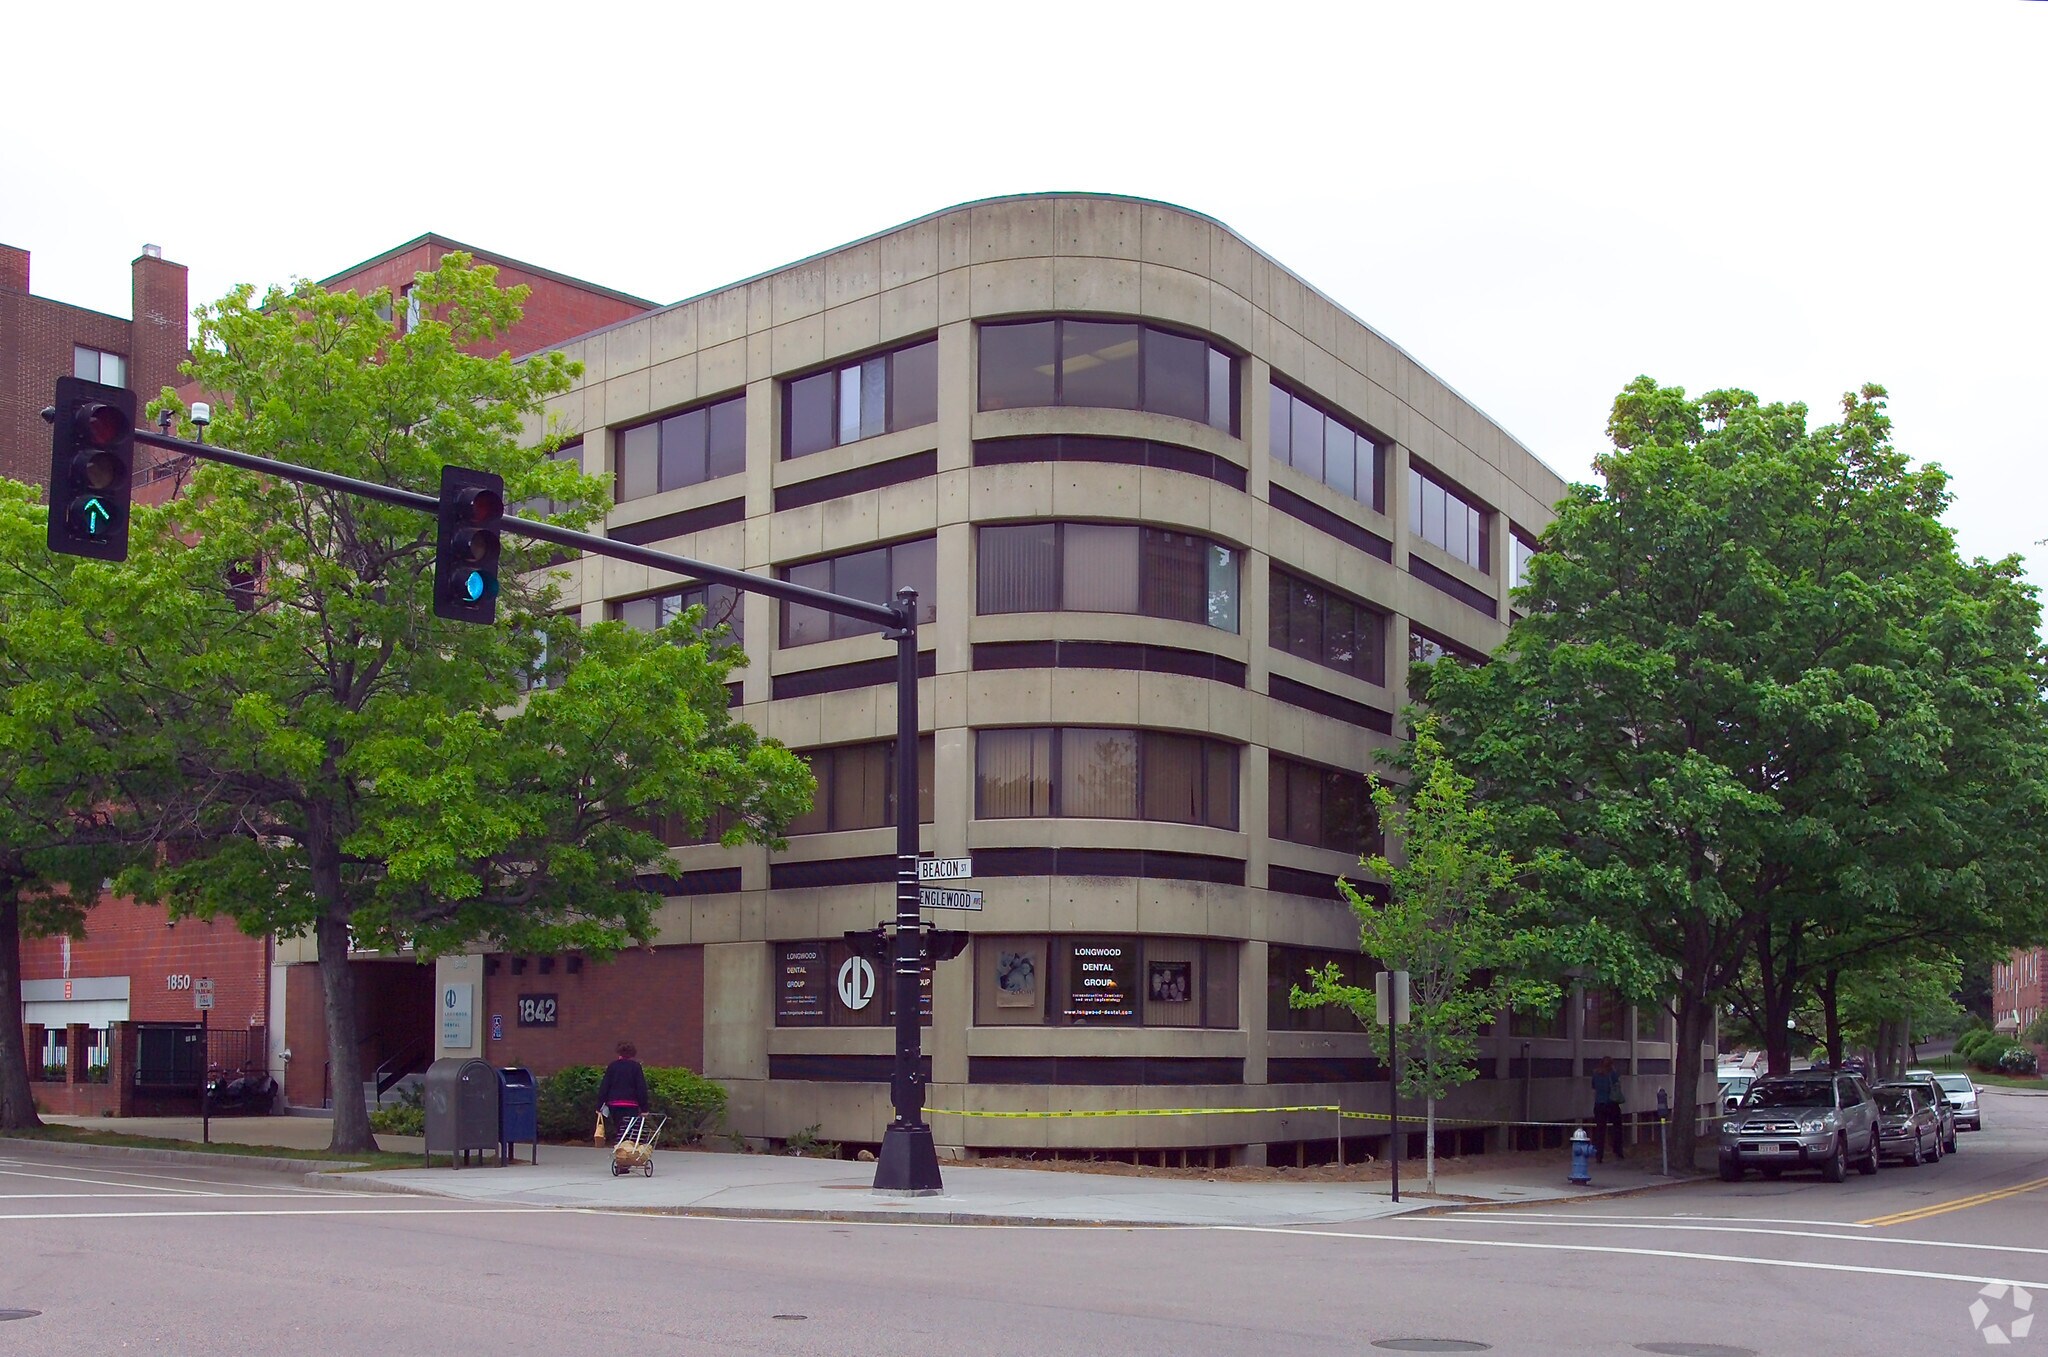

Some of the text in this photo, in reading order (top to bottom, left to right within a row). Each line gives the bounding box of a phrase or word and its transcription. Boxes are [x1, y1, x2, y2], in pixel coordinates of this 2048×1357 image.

[922, 861, 967, 877] BEACON ST
[920, 890, 982, 907] ENGLEWOOD AVE
[786, 952, 817, 960] LONGWOOD
[1074, 948, 1121, 956] LONGWOOD
[786, 966, 807, 974] DENTAL
[1082, 963, 1114, 971] DENTAL
[166, 974, 191, 990] 1850
[786, 980, 806, 988] GROUP
[519, 999, 556, 1022] 1842
